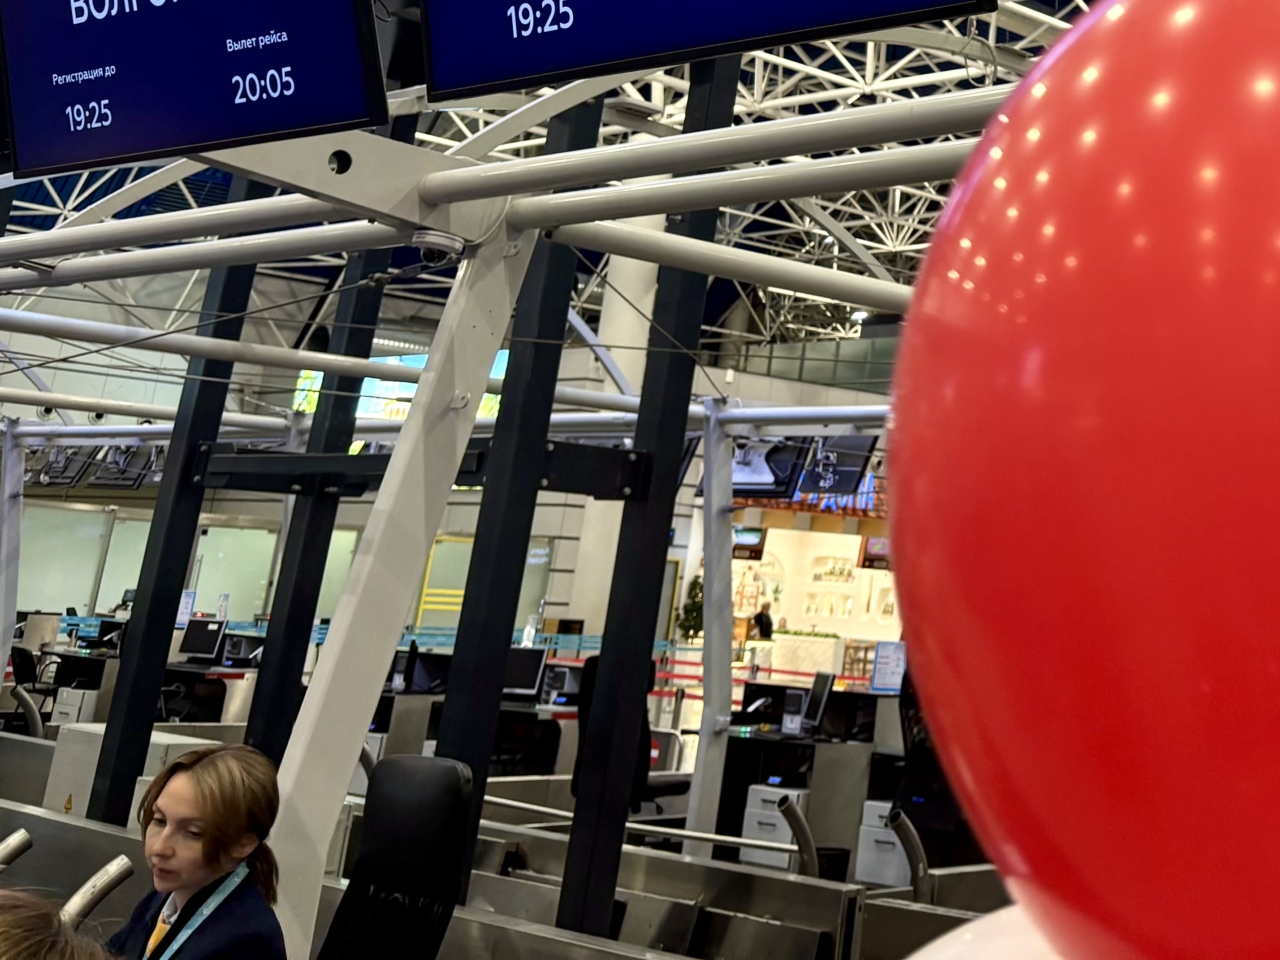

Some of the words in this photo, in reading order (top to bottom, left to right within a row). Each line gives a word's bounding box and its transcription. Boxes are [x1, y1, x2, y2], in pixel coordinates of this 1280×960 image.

[227, 38, 256, 51] Вылет
[259, 30, 288, 48] рейса
[53, 68, 103, 85] Регистрация
[105, 66, 115, 77] до
[232, 67, 294, 103] 20:05
[66, 100, 111, 131] 19:25
